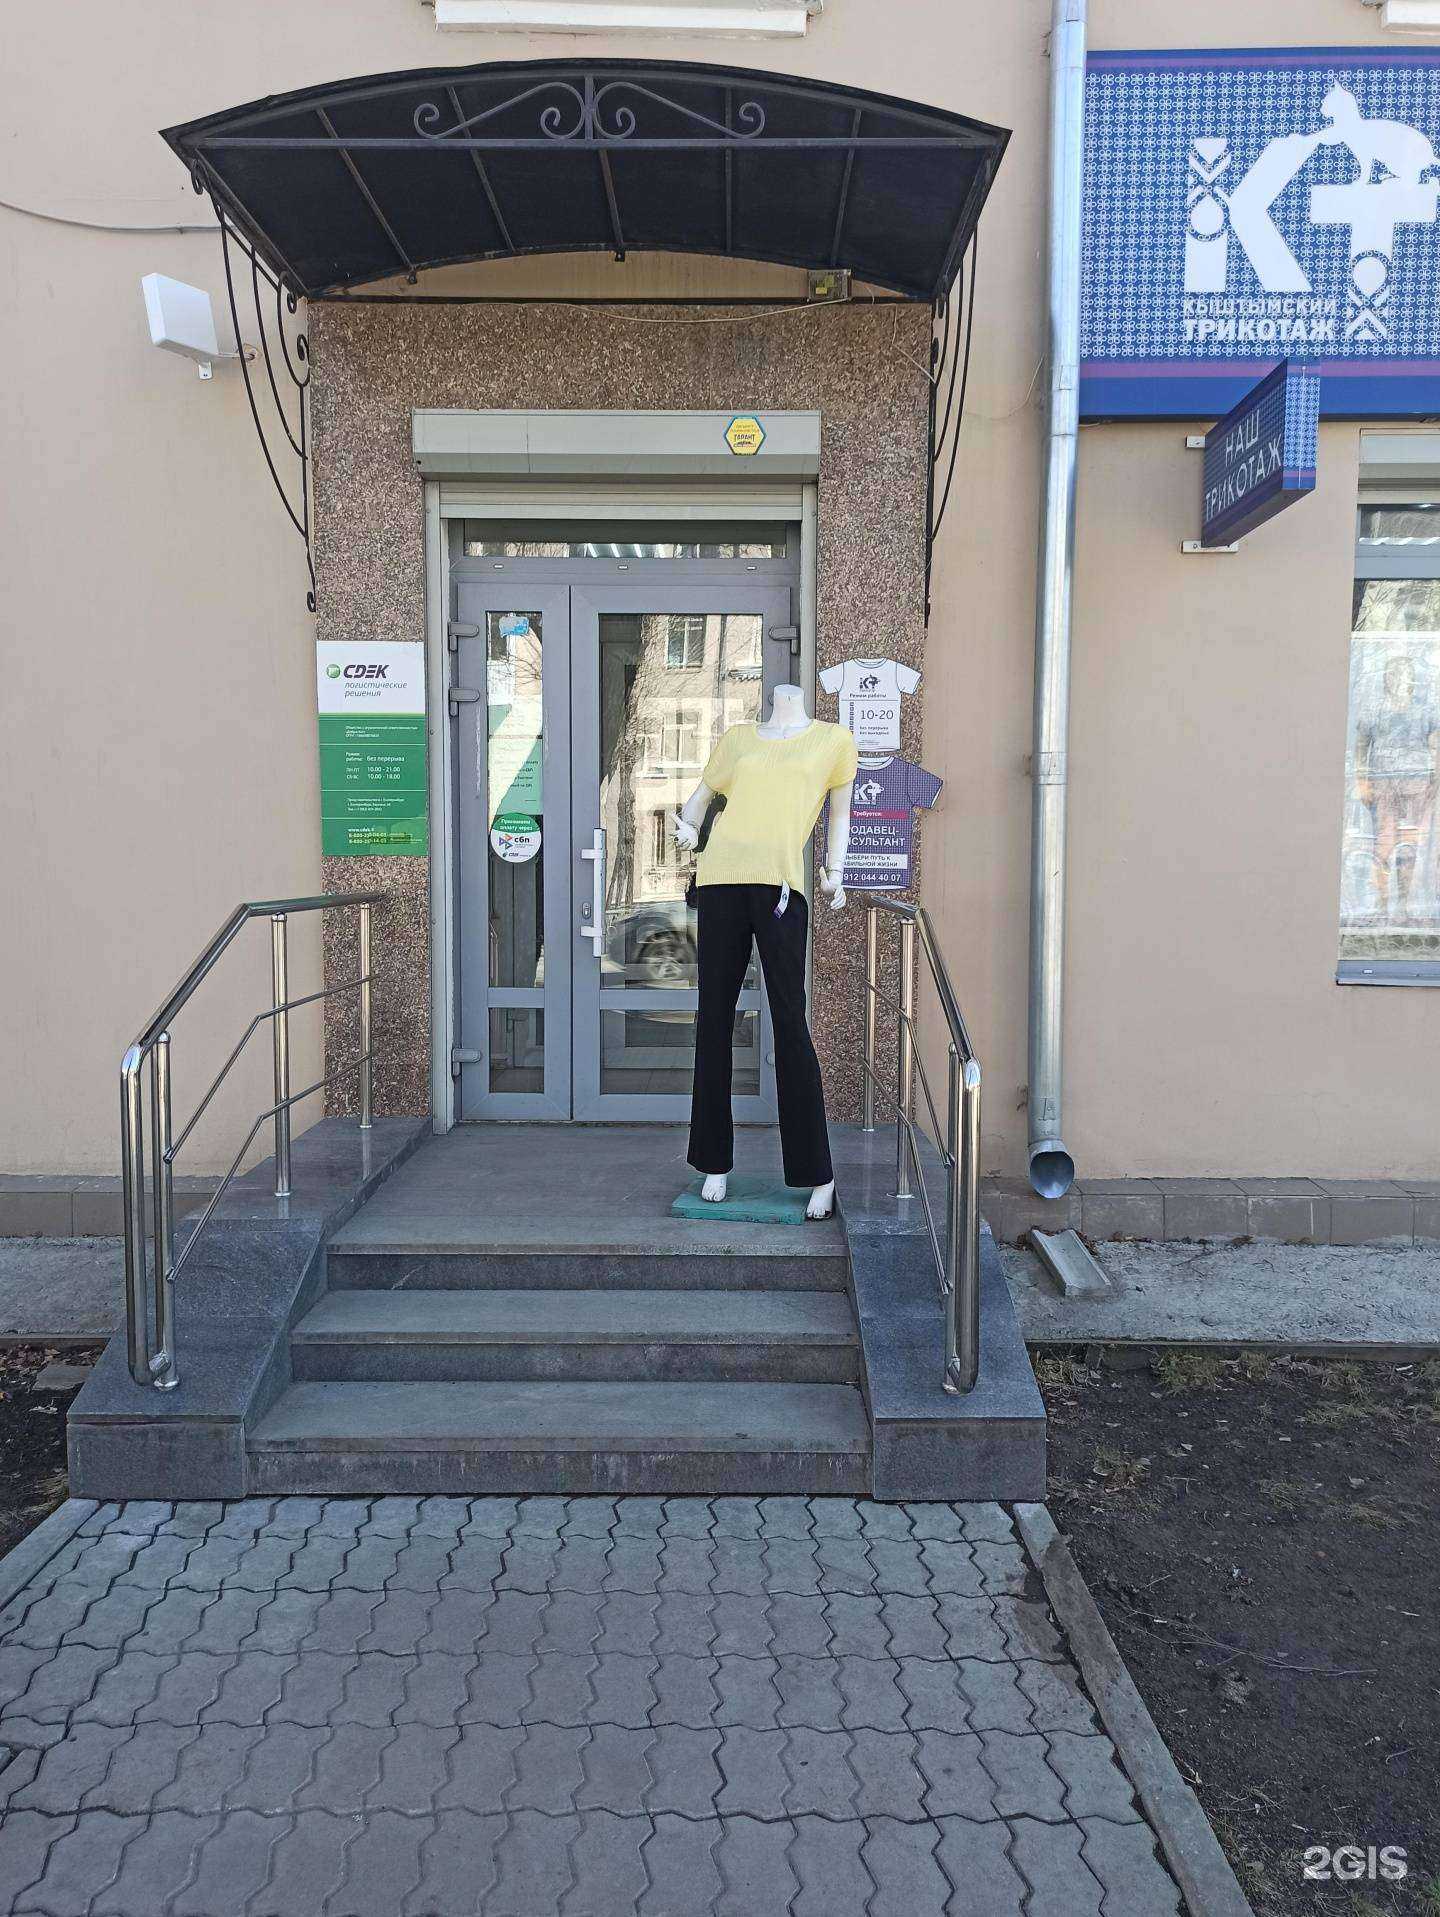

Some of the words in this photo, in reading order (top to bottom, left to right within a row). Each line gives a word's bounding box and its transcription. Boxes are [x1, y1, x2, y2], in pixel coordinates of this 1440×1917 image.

[1183, 319, 1335, 340] ТРИКОТАЖ
[1225, 409, 1260, 467] НАШ
[1205, 433, 1282, 522] ТРИКОТАЖ
[344, 665, 389, 678] CDEK
[344, 690, 381, 698] решения
[861, 710, 894, 720] 10-20
[850, 825, 900, 836] ОДАВЕЦ-
[848, 837, 906, 847] СУЛЬТАНТ
[861, 873, 877, 881] 044
[879, 873, 889, 882] 40
[891, 873, 901, 882] 07
